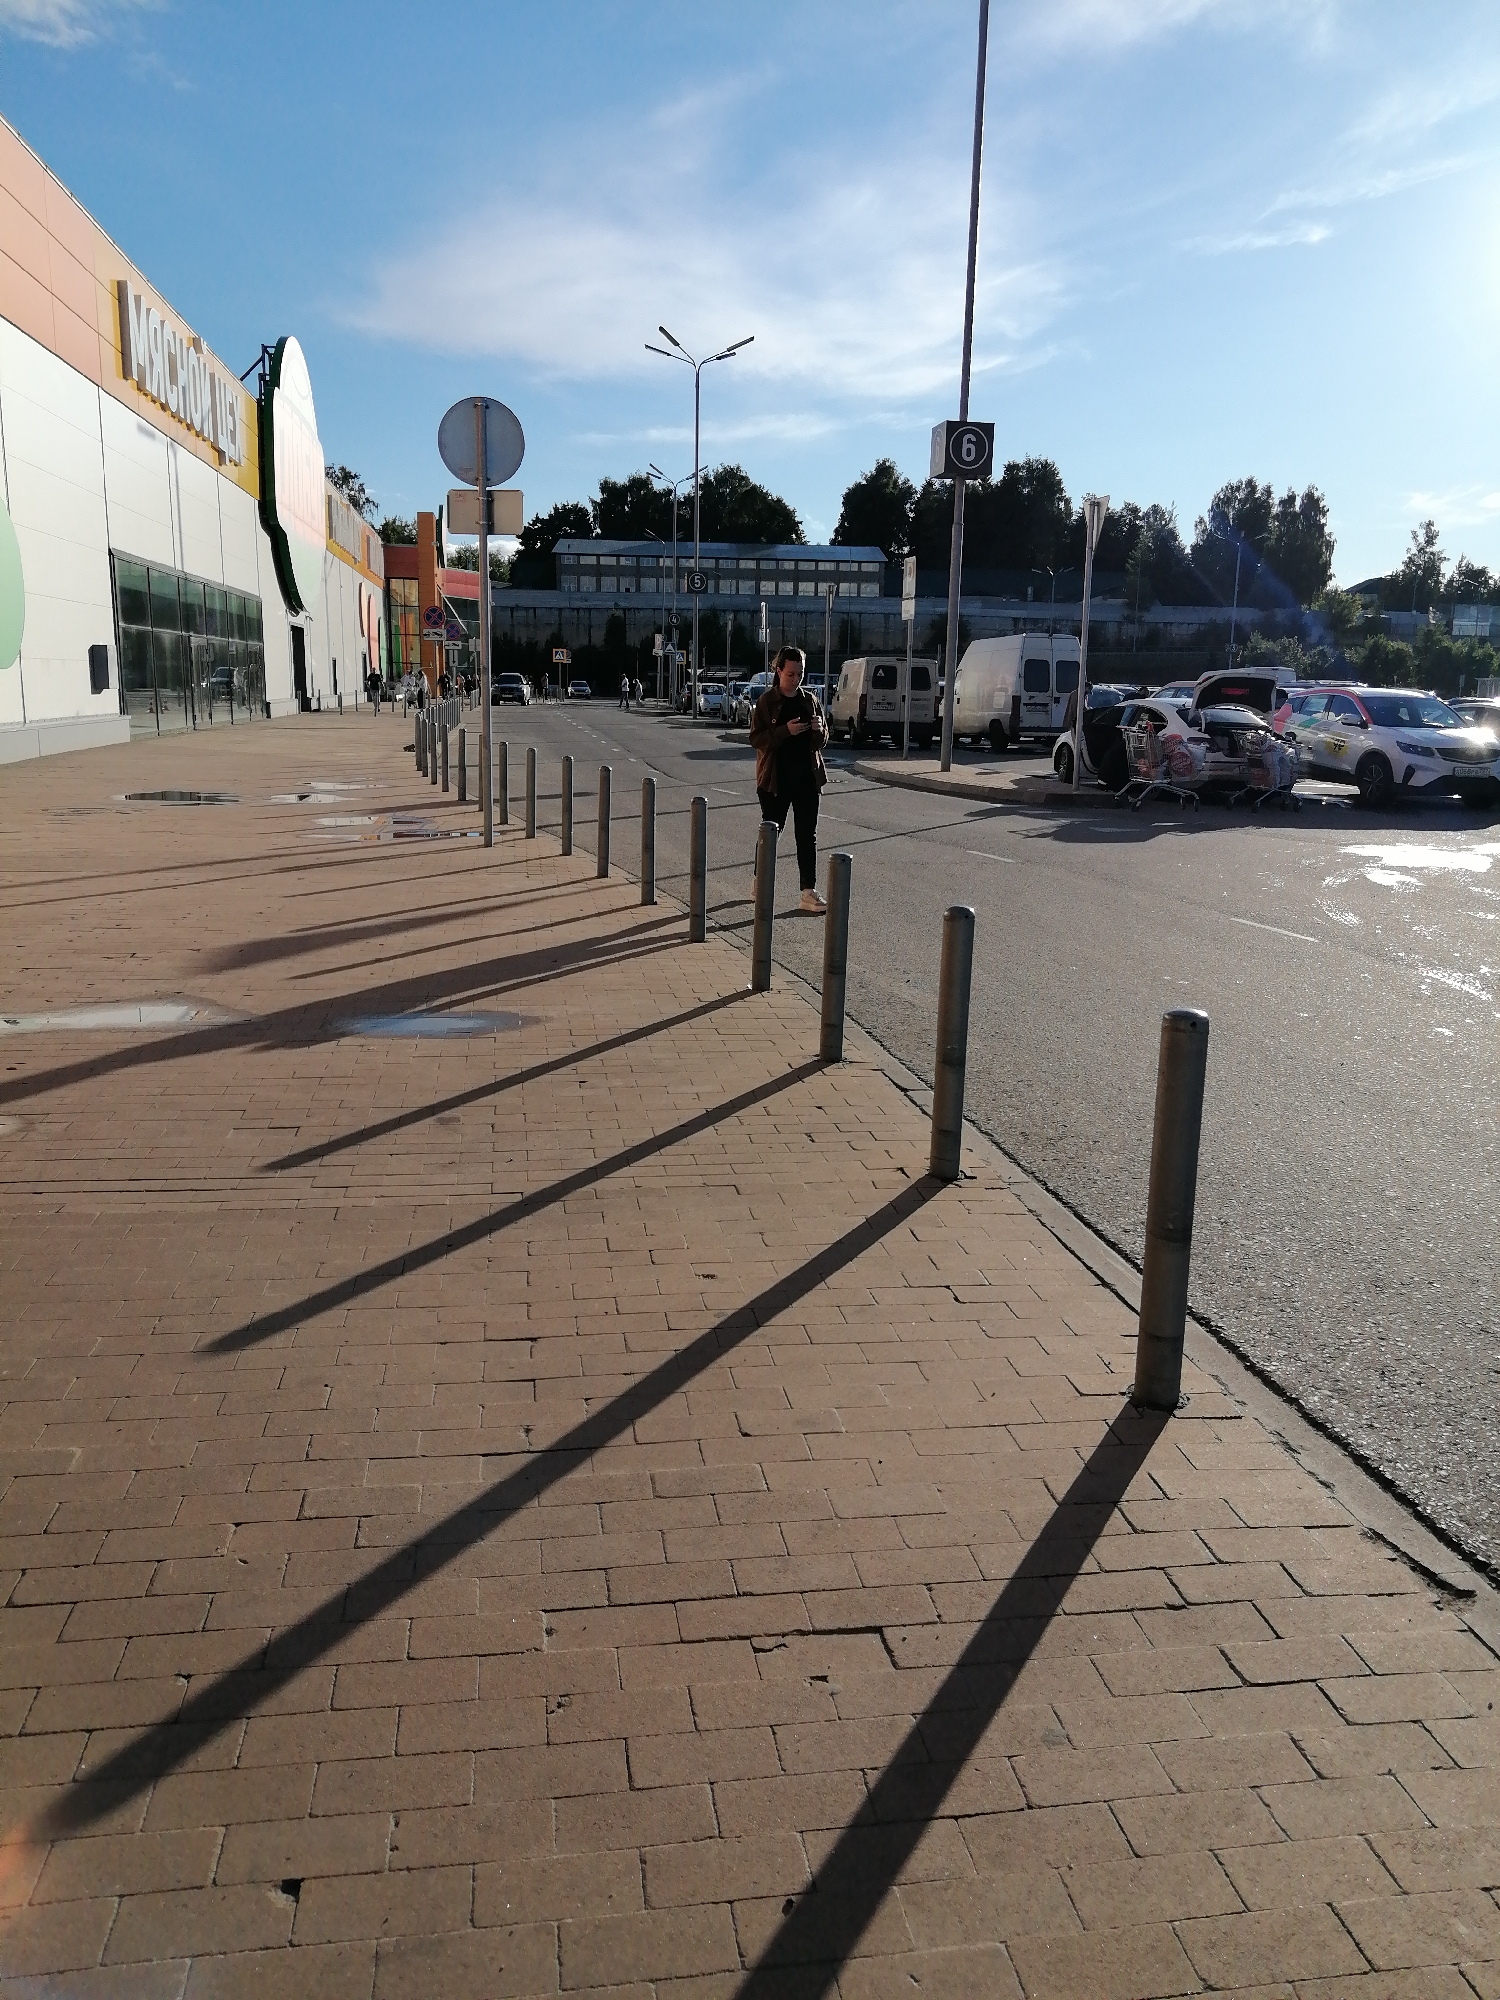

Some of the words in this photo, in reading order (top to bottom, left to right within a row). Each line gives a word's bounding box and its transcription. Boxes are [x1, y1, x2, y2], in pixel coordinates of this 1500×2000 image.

[124, 280, 214, 442] МЯСНОЙ
[214, 372, 244, 466] ЦЕХ
[962, 434, 977, 462] 6
[694, 575, 701, 588] 5
[671, 616, 677, 624] 4
